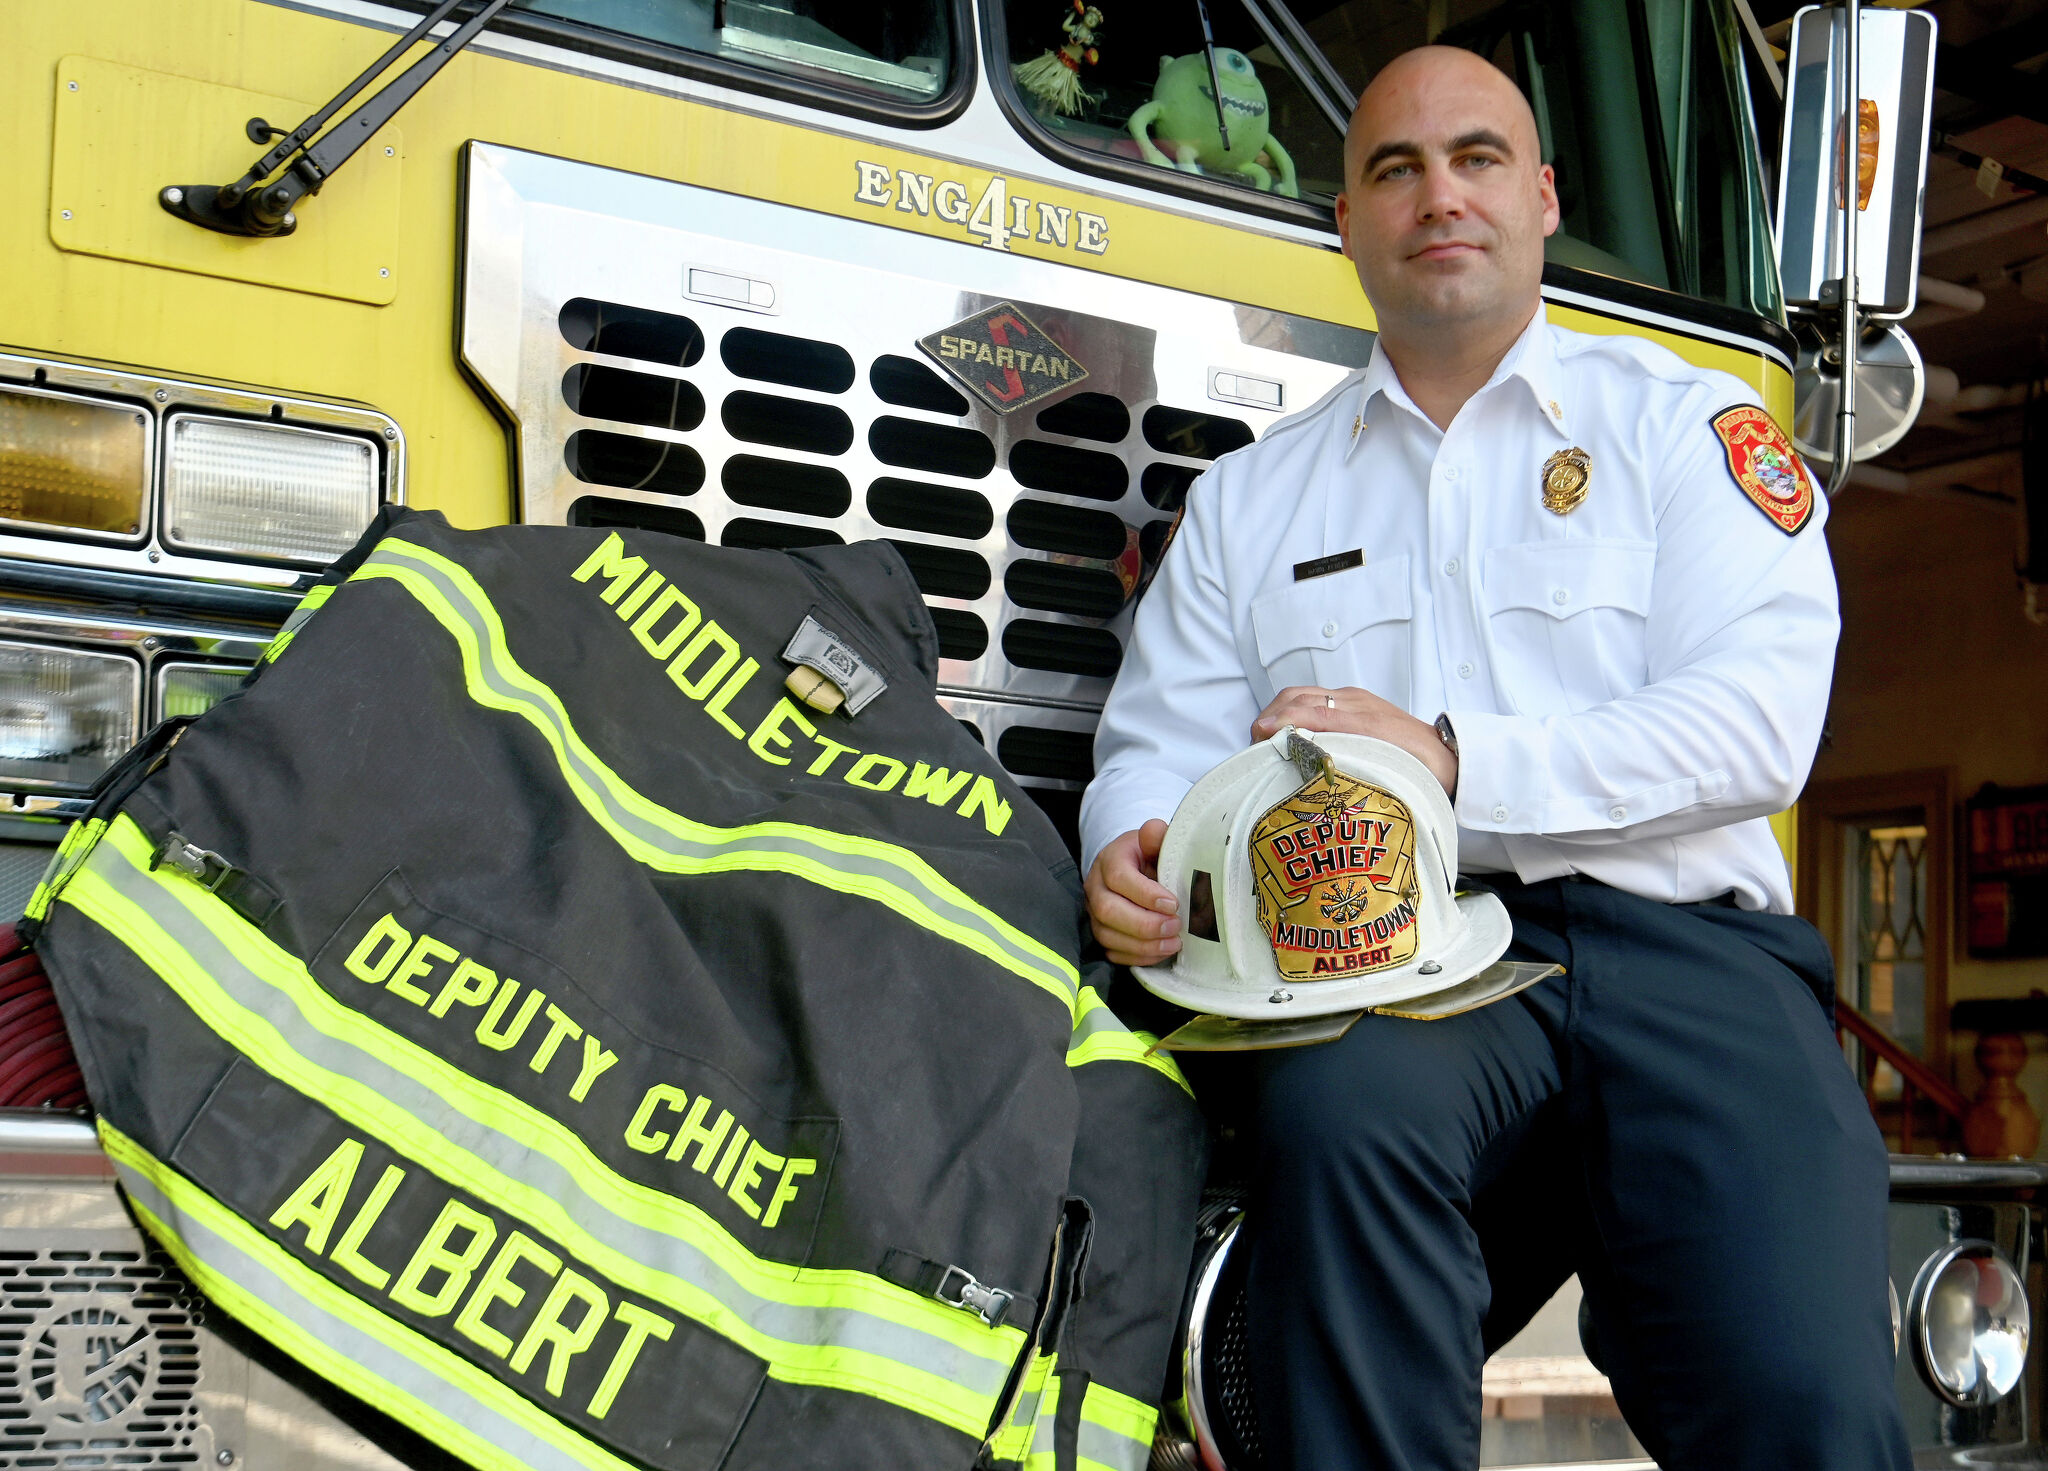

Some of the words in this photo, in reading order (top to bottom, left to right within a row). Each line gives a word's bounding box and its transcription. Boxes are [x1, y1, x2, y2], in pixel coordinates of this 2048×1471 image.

[940, 335, 1070, 380] SPARTAN
[571, 531, 1013, 837] MIDDLETOWN
[1271, 820, 1394, 861] DEPUTY
[1285, 846, 1389, 884] CHIEF
[1274, 900, 1416, 952] MIDDLETOWN
[1312, 945, 1392, 974] ALBERT
[344, 913, 618, 1103] DEPUTY
[624, 1083, 816, 1228] CHIEF
[269, 1137, 675, 1420] ALBERT
